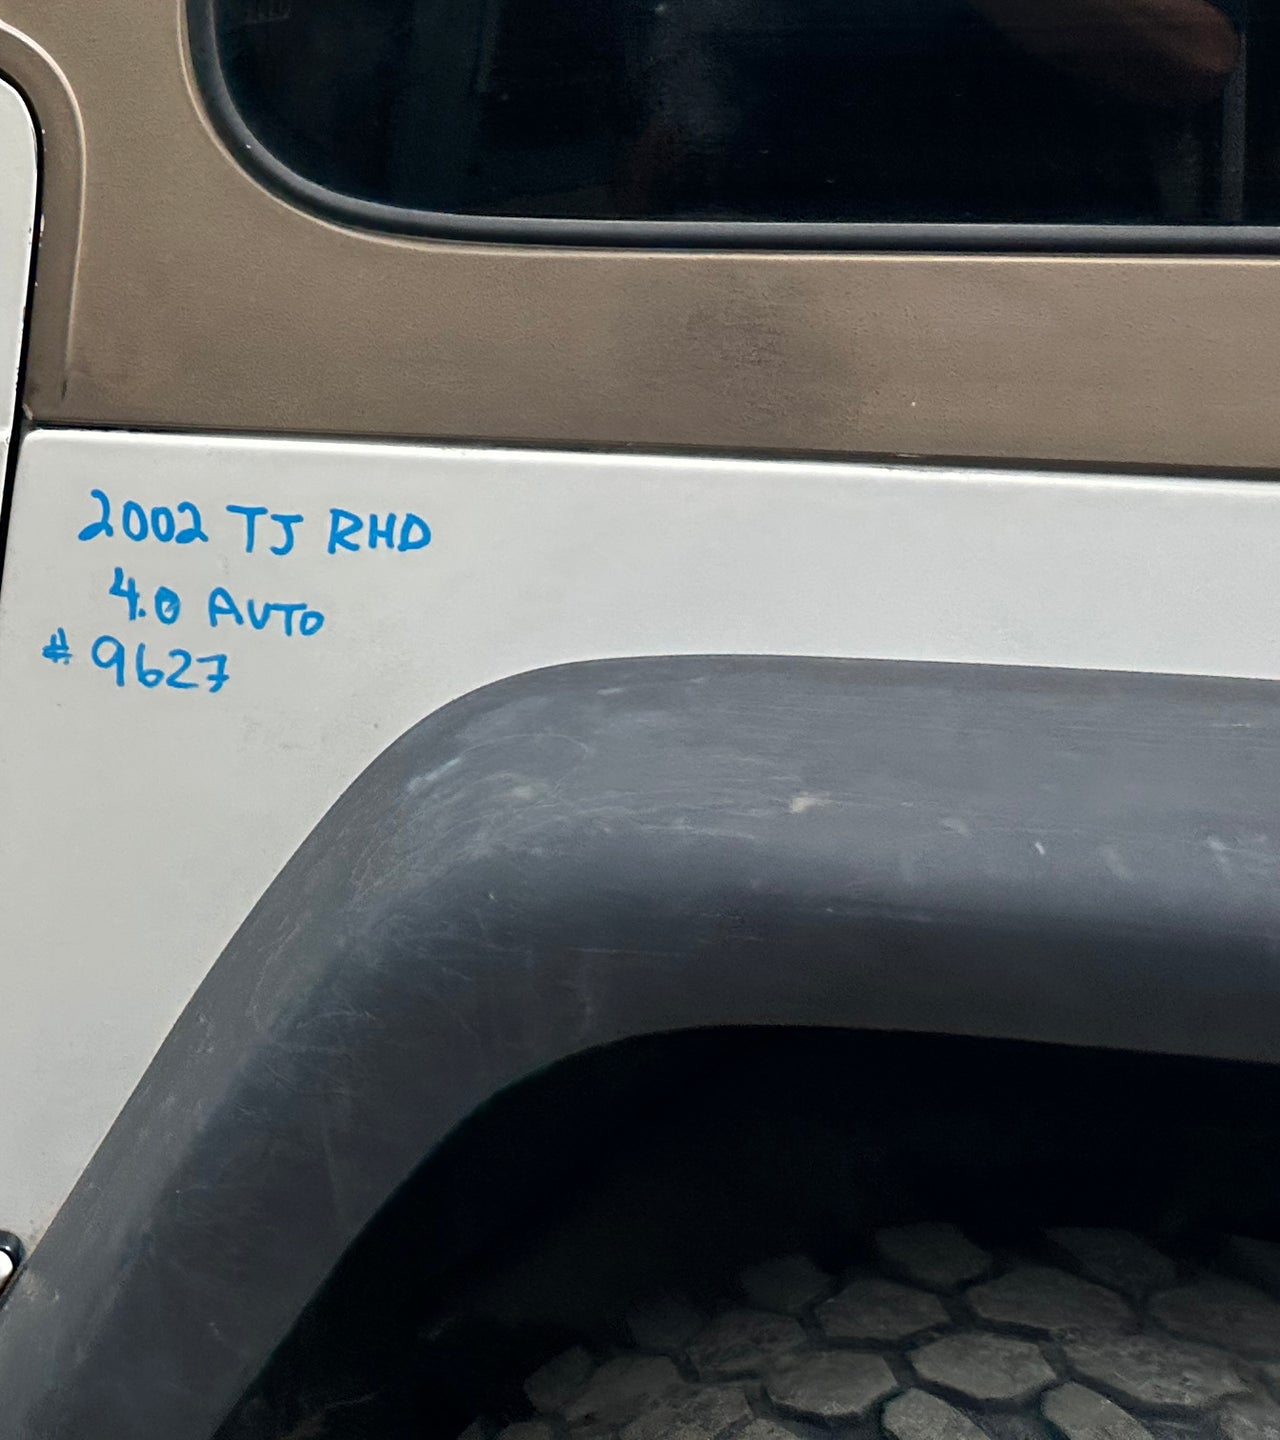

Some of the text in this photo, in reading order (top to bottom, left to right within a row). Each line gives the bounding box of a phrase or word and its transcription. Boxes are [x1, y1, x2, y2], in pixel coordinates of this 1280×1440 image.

[78, 489, 432, 556] 2002 TJ RHD
[109, 566, 325, 637] 4.0 AUTO
[91, 635, 230, 693] 9627
